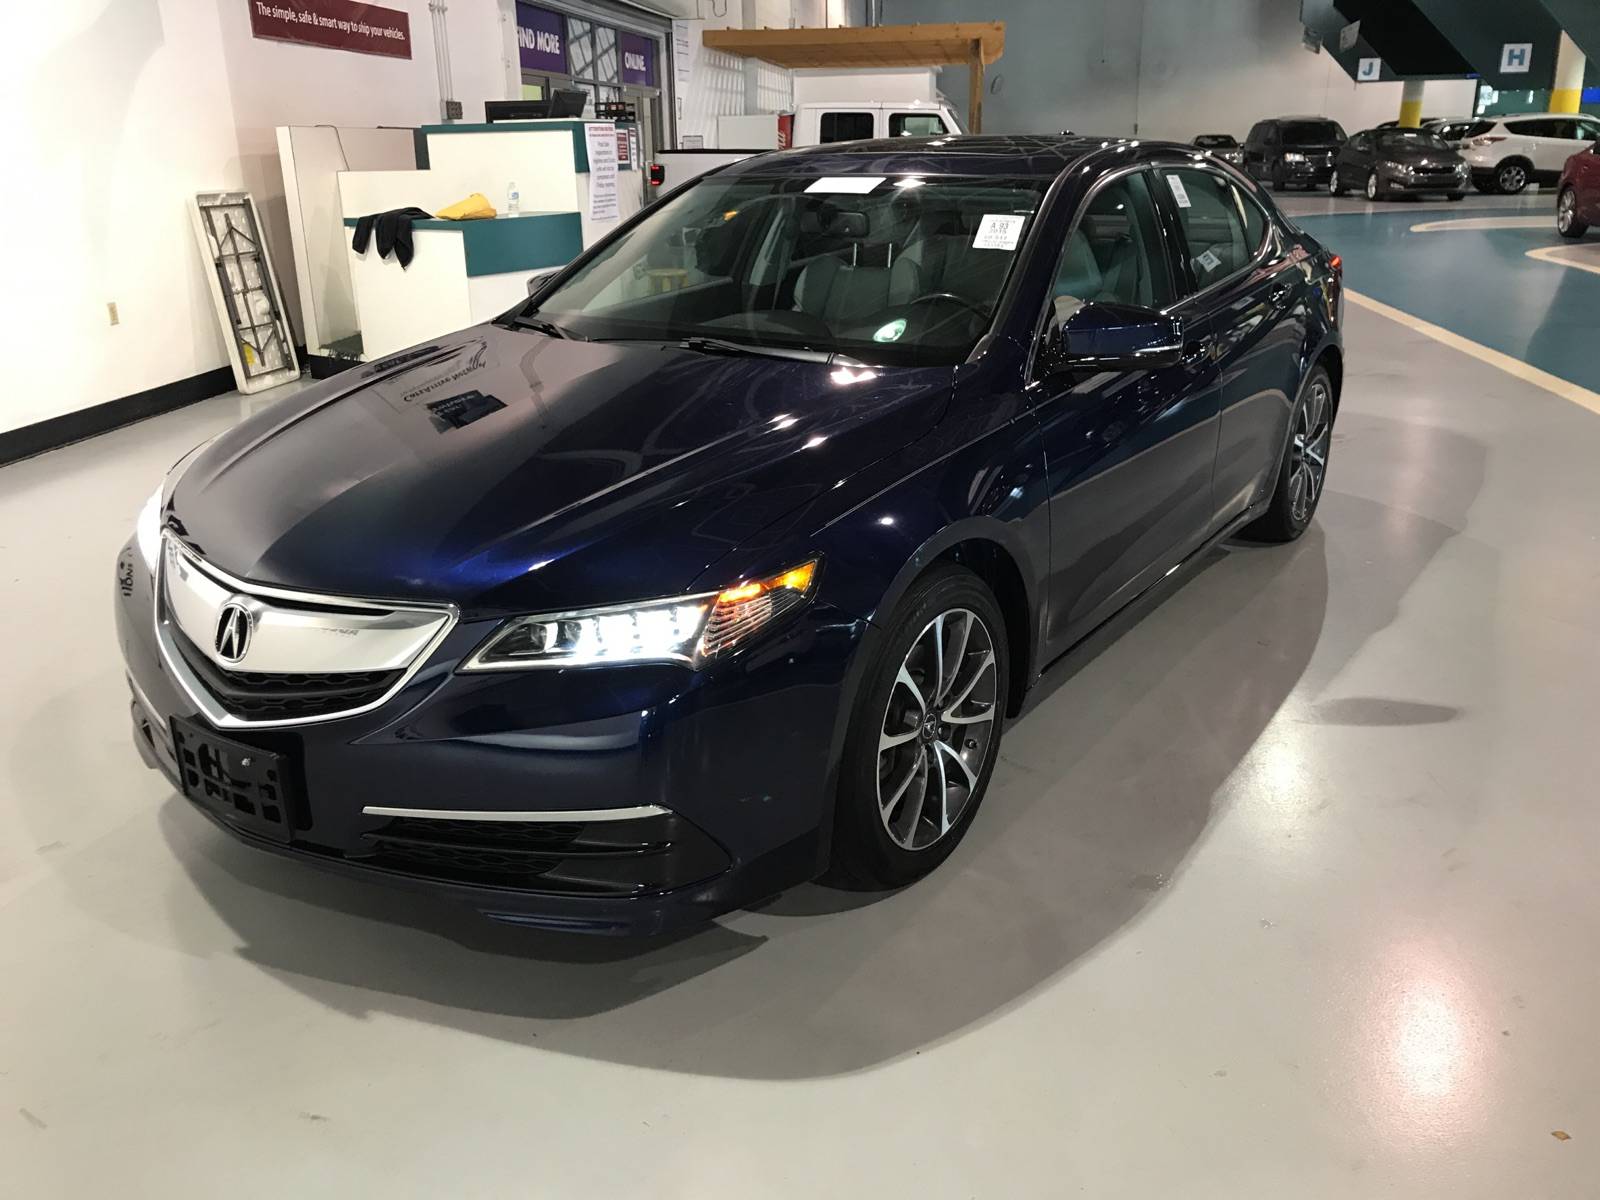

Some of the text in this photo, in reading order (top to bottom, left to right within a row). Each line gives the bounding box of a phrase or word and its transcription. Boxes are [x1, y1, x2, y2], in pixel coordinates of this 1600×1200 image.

[256, 2, 406, 40] The simple, safe & smart way to ship your vehicles.
[537, 31, 560, 55] MORE
[1507, 48, 1525, 66] H
[1362, 61, 1374, 77] J
